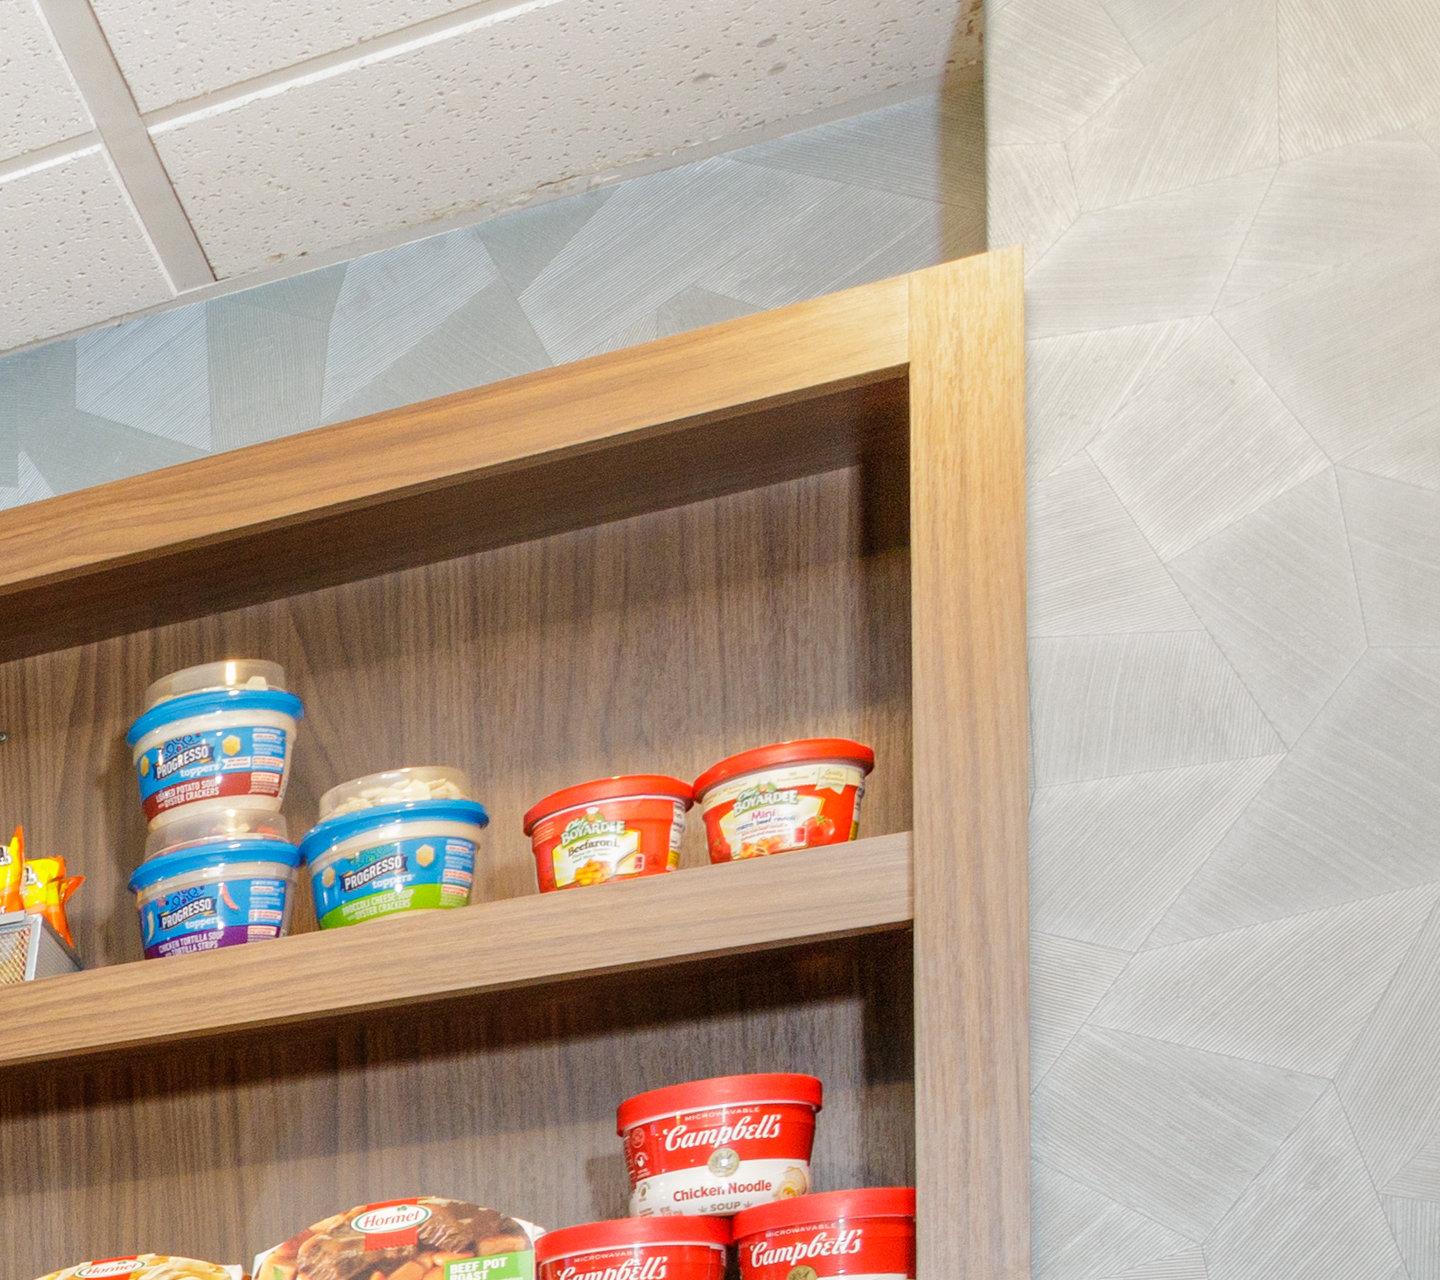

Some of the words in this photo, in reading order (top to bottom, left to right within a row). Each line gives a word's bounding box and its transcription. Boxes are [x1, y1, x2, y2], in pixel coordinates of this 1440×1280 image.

[155, 747, 209, 780] PROGRESSO
[180, 762, 220, 777] toppers
[733, 790, 798, 815] BOYARDEE
[561, 820, 626, 844] BOYARDEE
[344, 854, 403, 890] PROGRESSO
[372, 874, 412, 889] toppers
[162, 899, 212, 930] PROGRESSO
[663, 1114, 782, 1151] Campbell's
[674, 1185, 725, 1202] Chicken
[729, 1180, 772, 1195] Noodle
[710, 1201, 741, 1212] SOUP
[362, 1208, 420, 1232] Hormel
[750, 1229, 863, 1268] Campbell's
[450, 1261, 479, 1275] BEEF
[481, 1257, 508, 1270] POT
